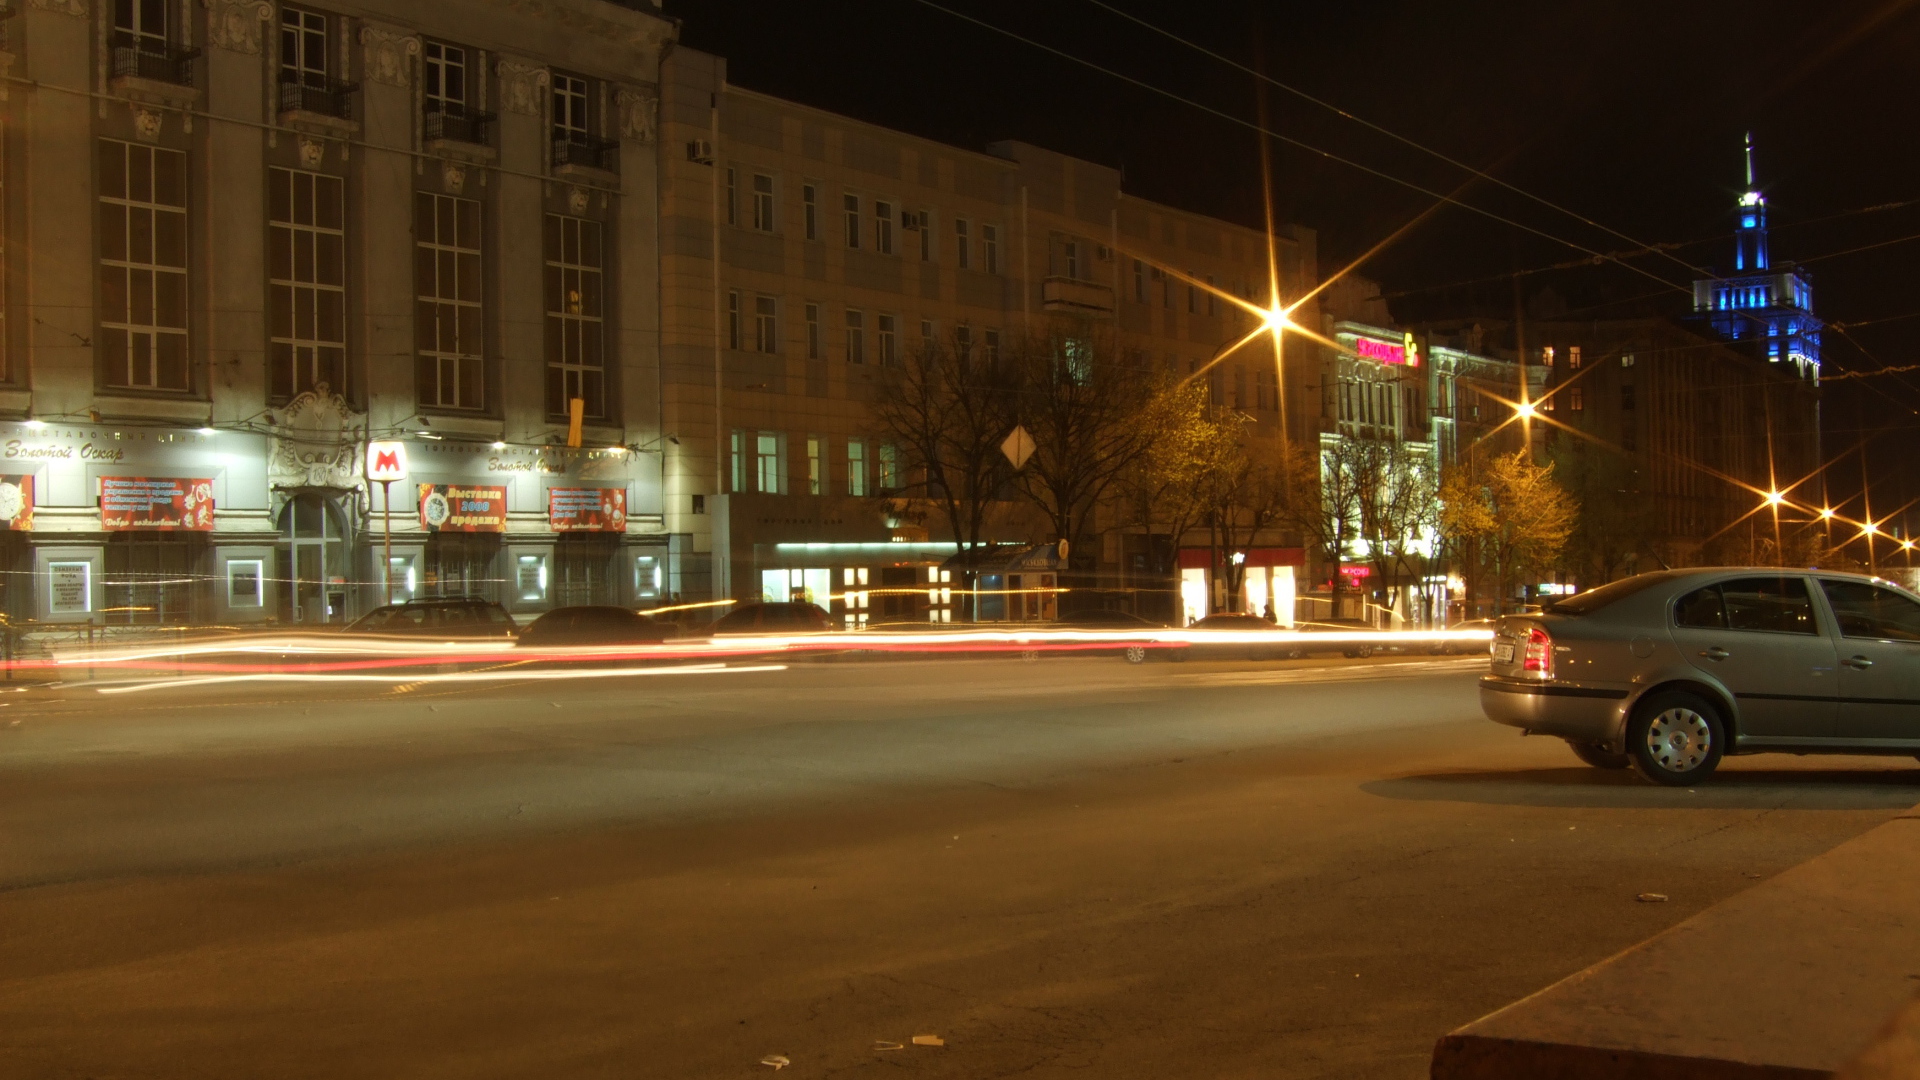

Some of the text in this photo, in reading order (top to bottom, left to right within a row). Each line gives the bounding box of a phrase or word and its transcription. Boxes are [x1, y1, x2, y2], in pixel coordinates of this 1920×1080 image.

[158, 433, 207, 443] ЦЕНТР
[5, 439, 124, 464] Золотой Оскар
[488, 457, 566, 476] Золотой Оскар
[448, 487, 501, 499] Выставка
[105, 517, 129, 527] Добро
[451, 515, 500, 527] продажа
